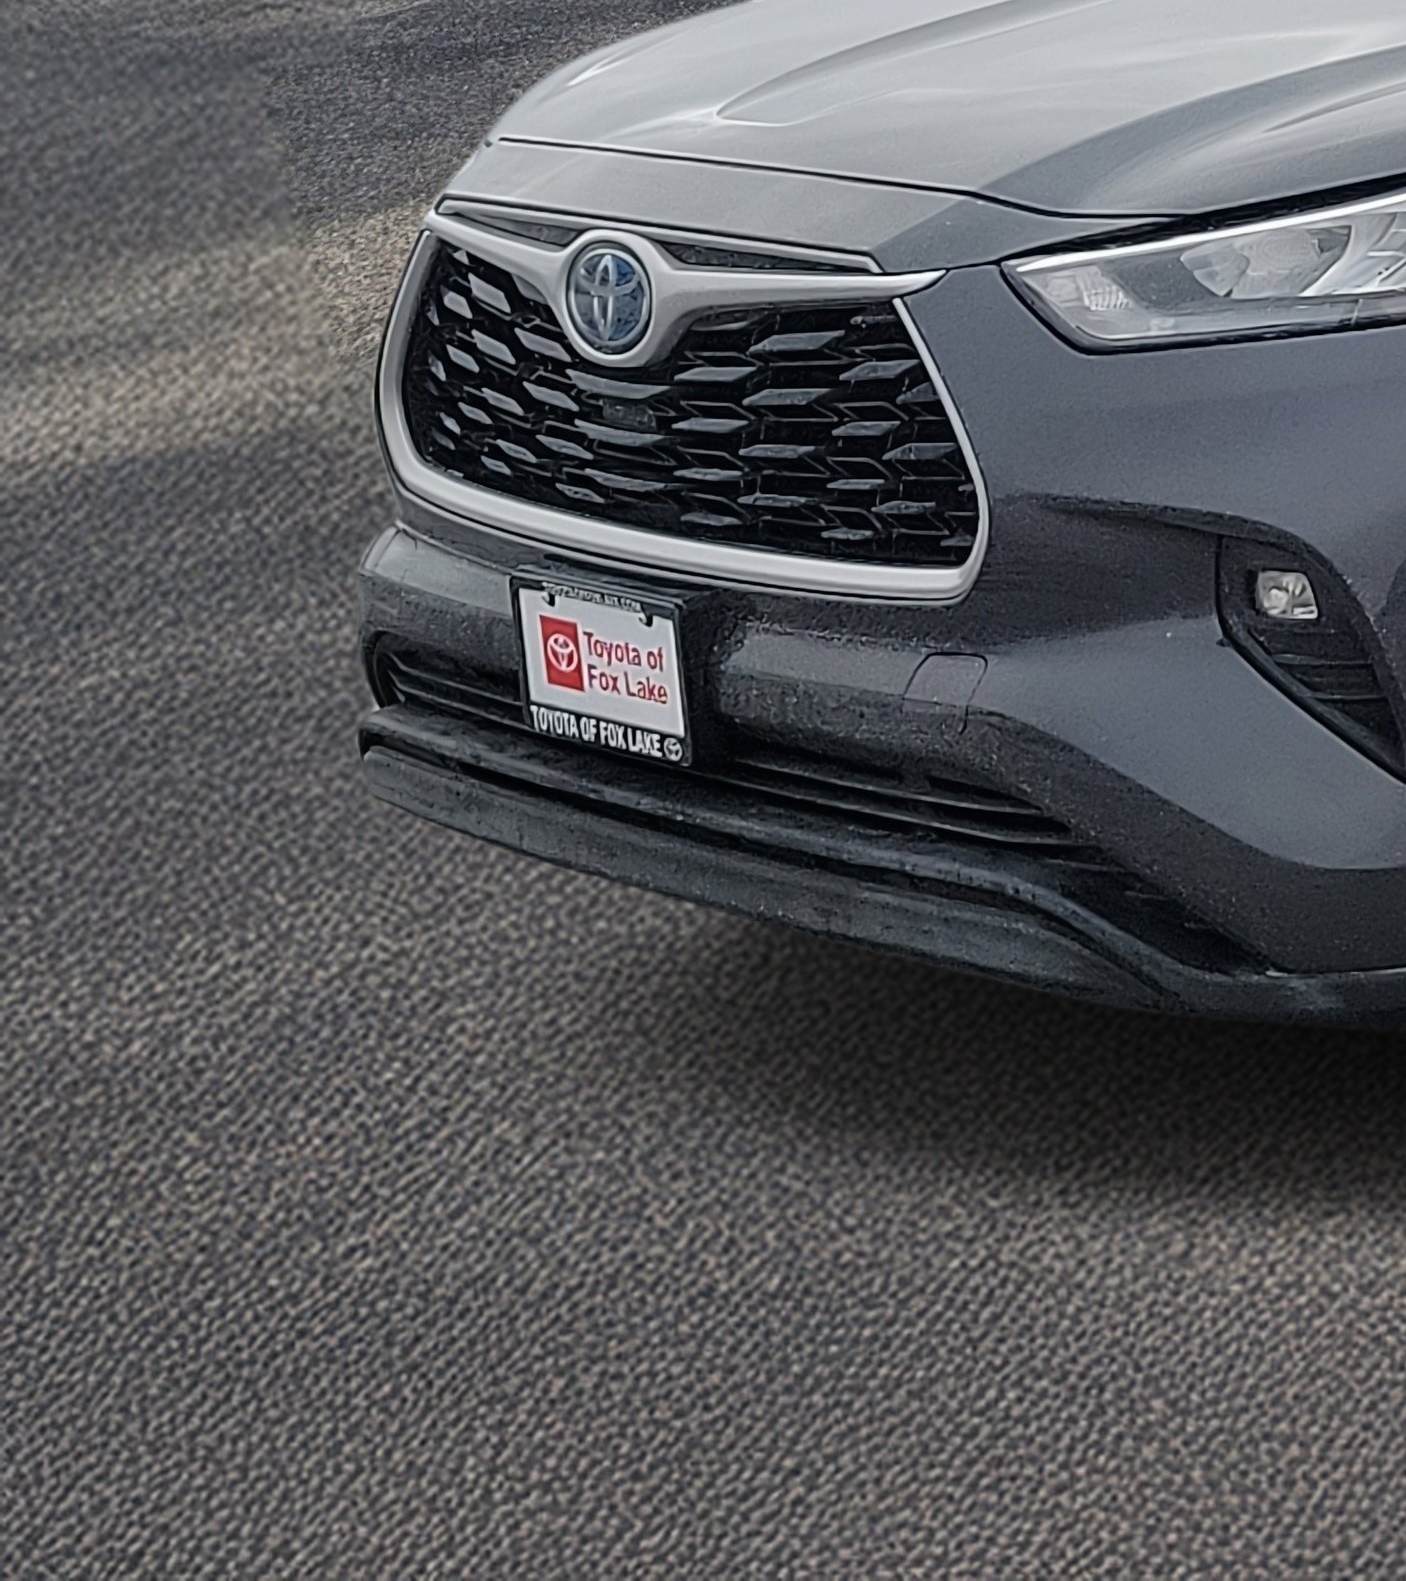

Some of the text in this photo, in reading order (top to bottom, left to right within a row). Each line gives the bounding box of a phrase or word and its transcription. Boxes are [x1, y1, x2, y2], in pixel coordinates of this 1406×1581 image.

[583, 631, 665, 672] Toyota of
[587, 664, 669, 705] Fox Lake
[529, 705, 664, 758] TOYOTA OF FOX LAKE
